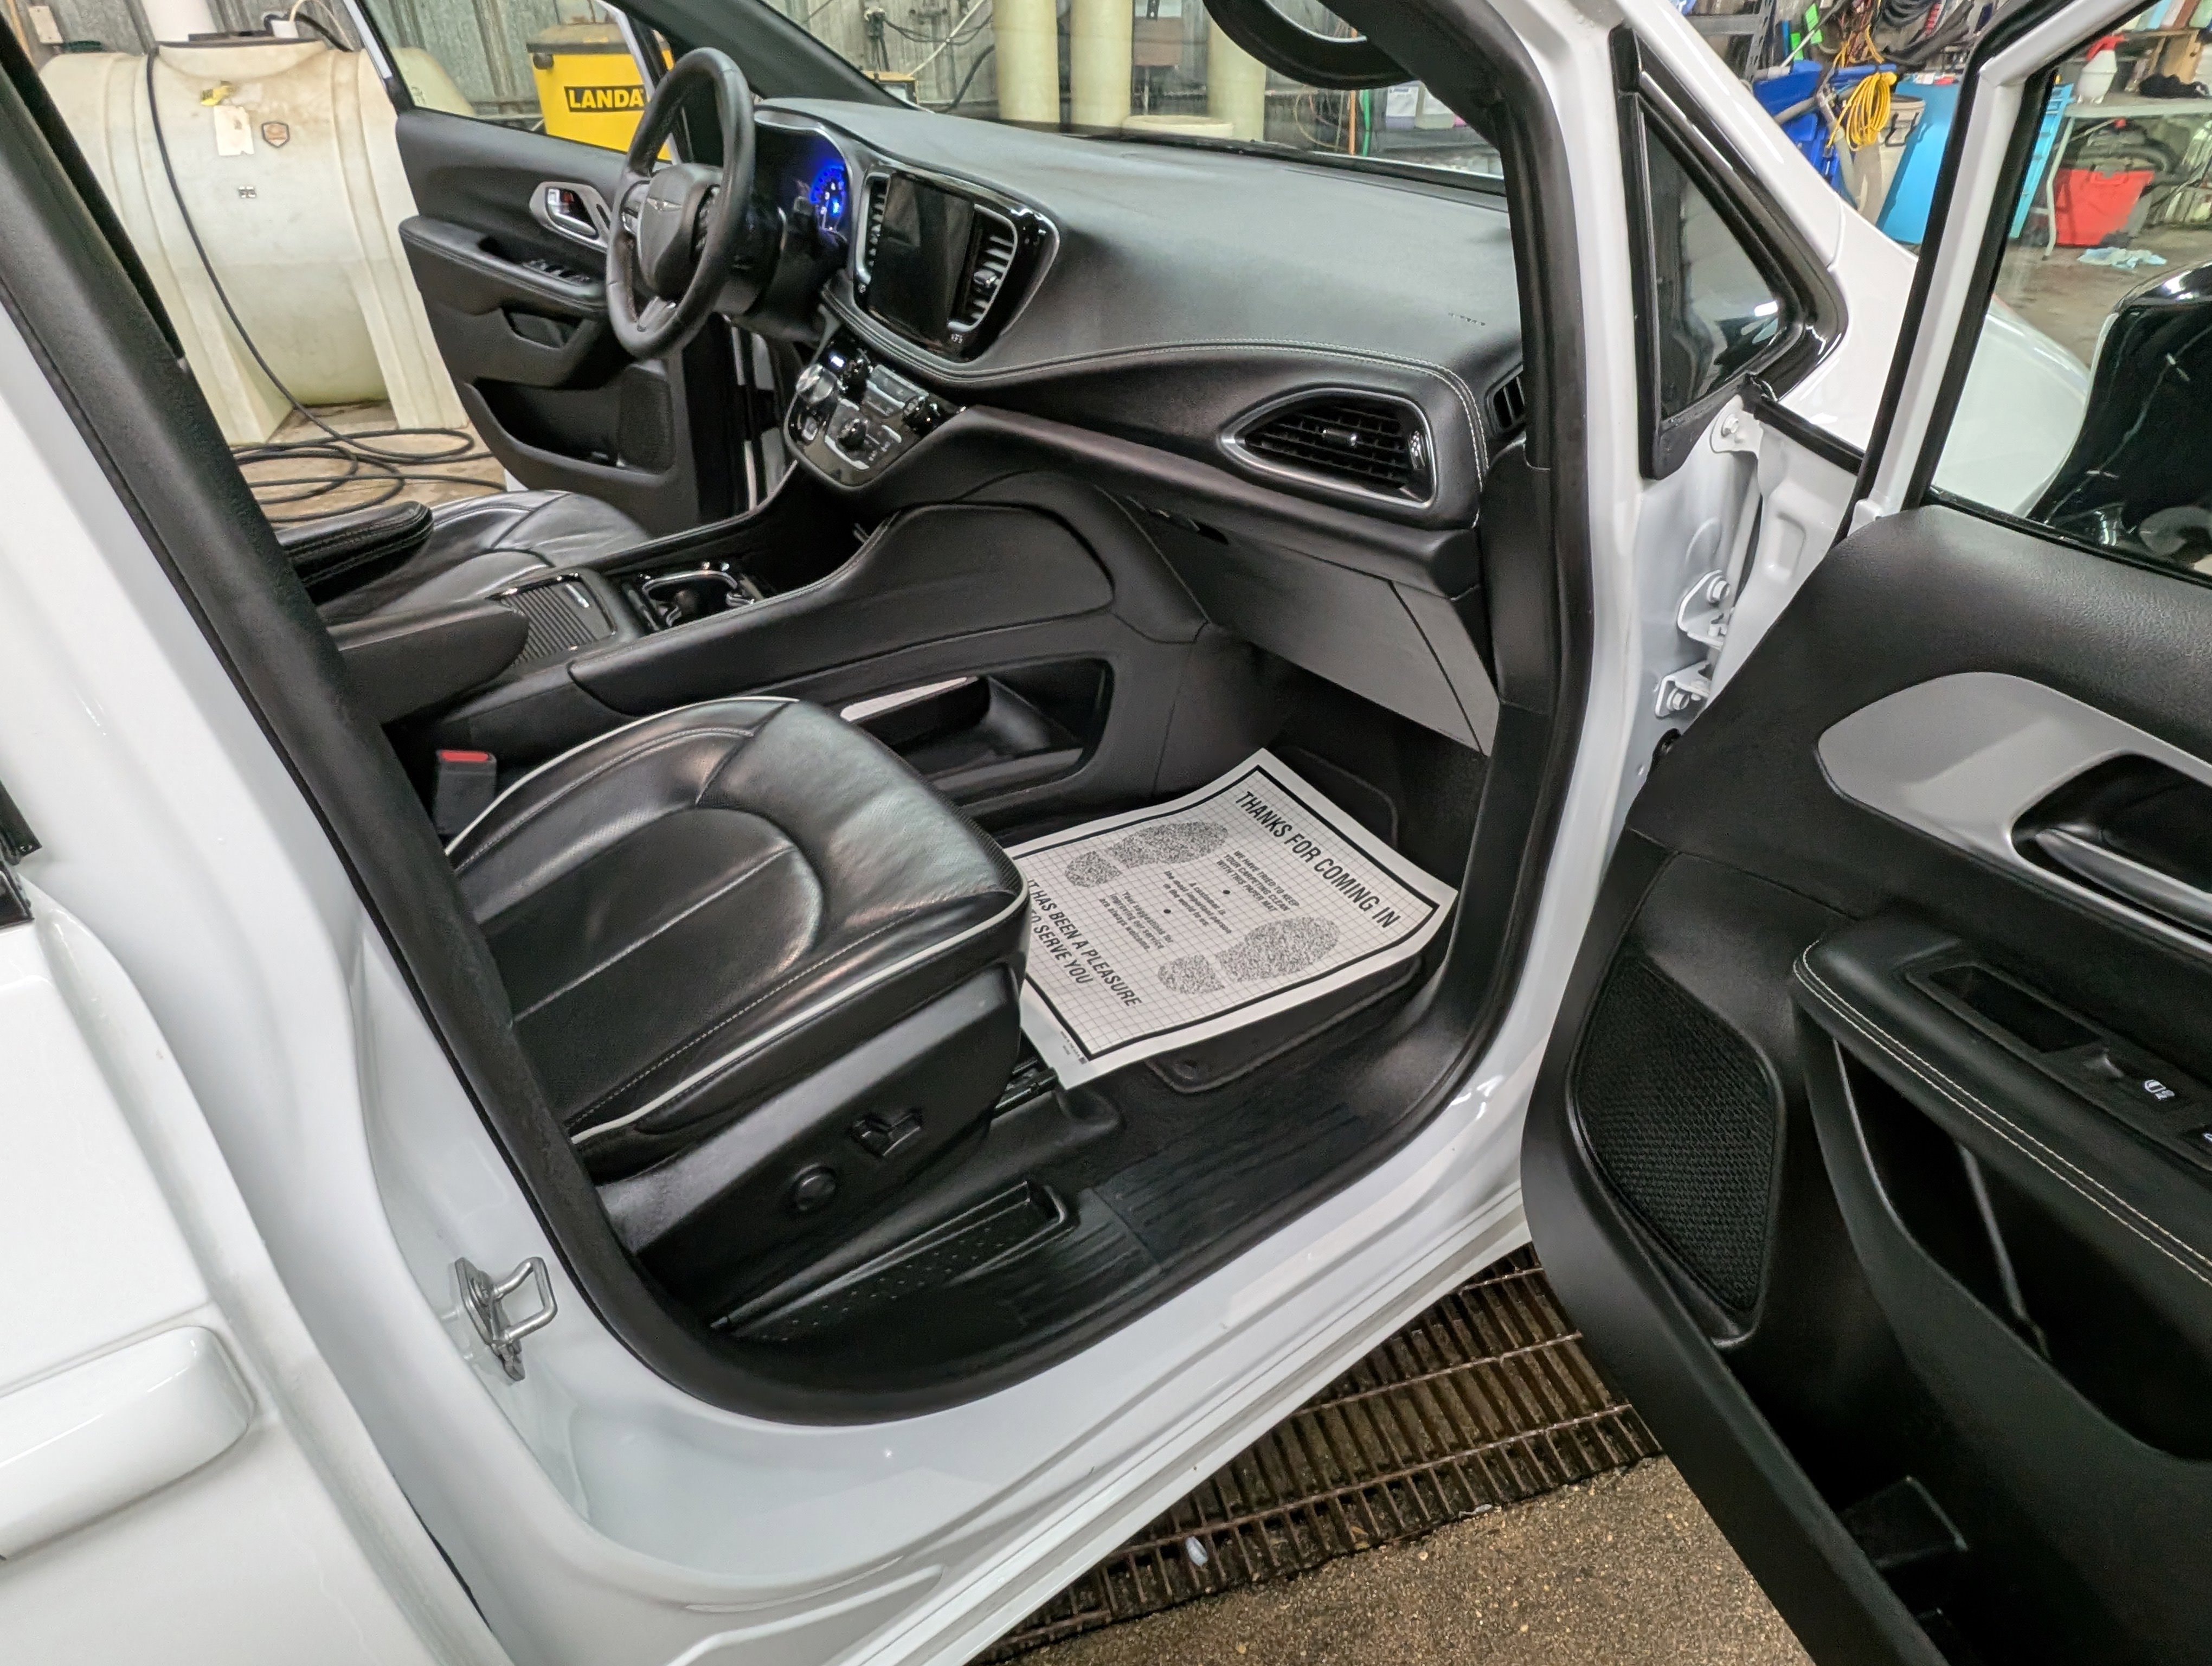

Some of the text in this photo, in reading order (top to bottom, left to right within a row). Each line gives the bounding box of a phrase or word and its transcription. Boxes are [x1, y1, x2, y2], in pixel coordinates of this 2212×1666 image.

[569, 88, 644, 108] LANDA
[1224, 854, 1290, 911] YOUR CARPETING CLEAN
[1234, 850, 1300, 907] WE HAVE TRIED TO KEEP
[1236, 791, 1401, 928] THANKS FOR COMING IN
[1186, 892, 1214, 916] important
[1193, 887, 1220, 909] customer
[1217, 860, 1278, 912] WITH THIS PAPER MAT
[1122, 892, 1136, 904] Your
[1133, 905, 1166, 935] suggestions
[1134, 920, 1146, 928] our
[1142, 930, 1164, 949] service
[1033, 890, 1057, 911] HAS
[1049, 911, 1082, 940] BEEN
[1072, 940, 1090, 950] A
[1081, 949, 1142, 1007] PLEASURE
[1033, 925, 1072, 960] SERVE
[1064, 959, 1094, 984] YOU
